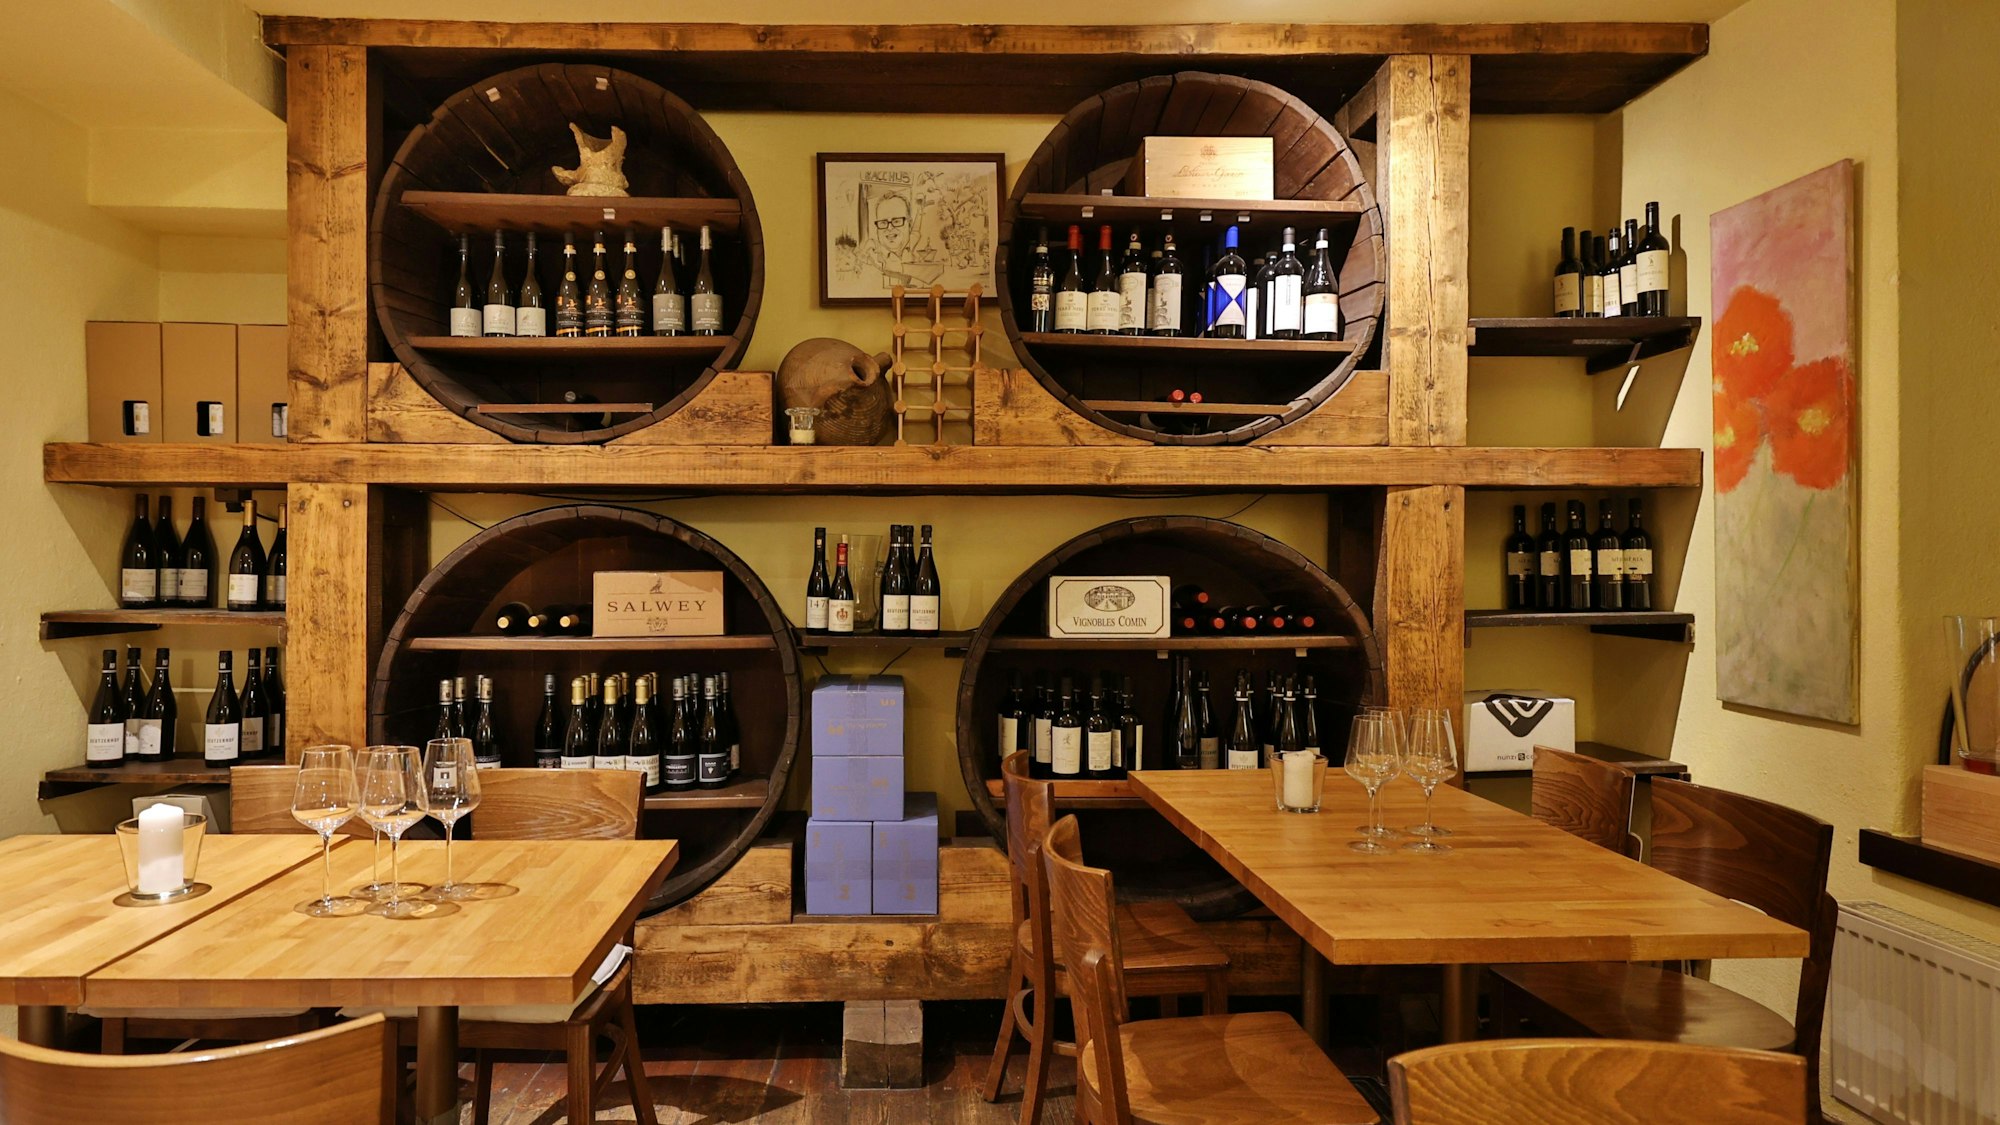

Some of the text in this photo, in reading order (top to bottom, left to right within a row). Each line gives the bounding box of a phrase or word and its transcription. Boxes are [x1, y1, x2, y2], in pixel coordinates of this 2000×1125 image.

[865, 171, 910, 183] BACCHUS
[607, 600, 707, 613] SALWEY
[810, 599, 826, 608] 147
[1073, 615, 1147, 627] VIGNOBLES COMIN
